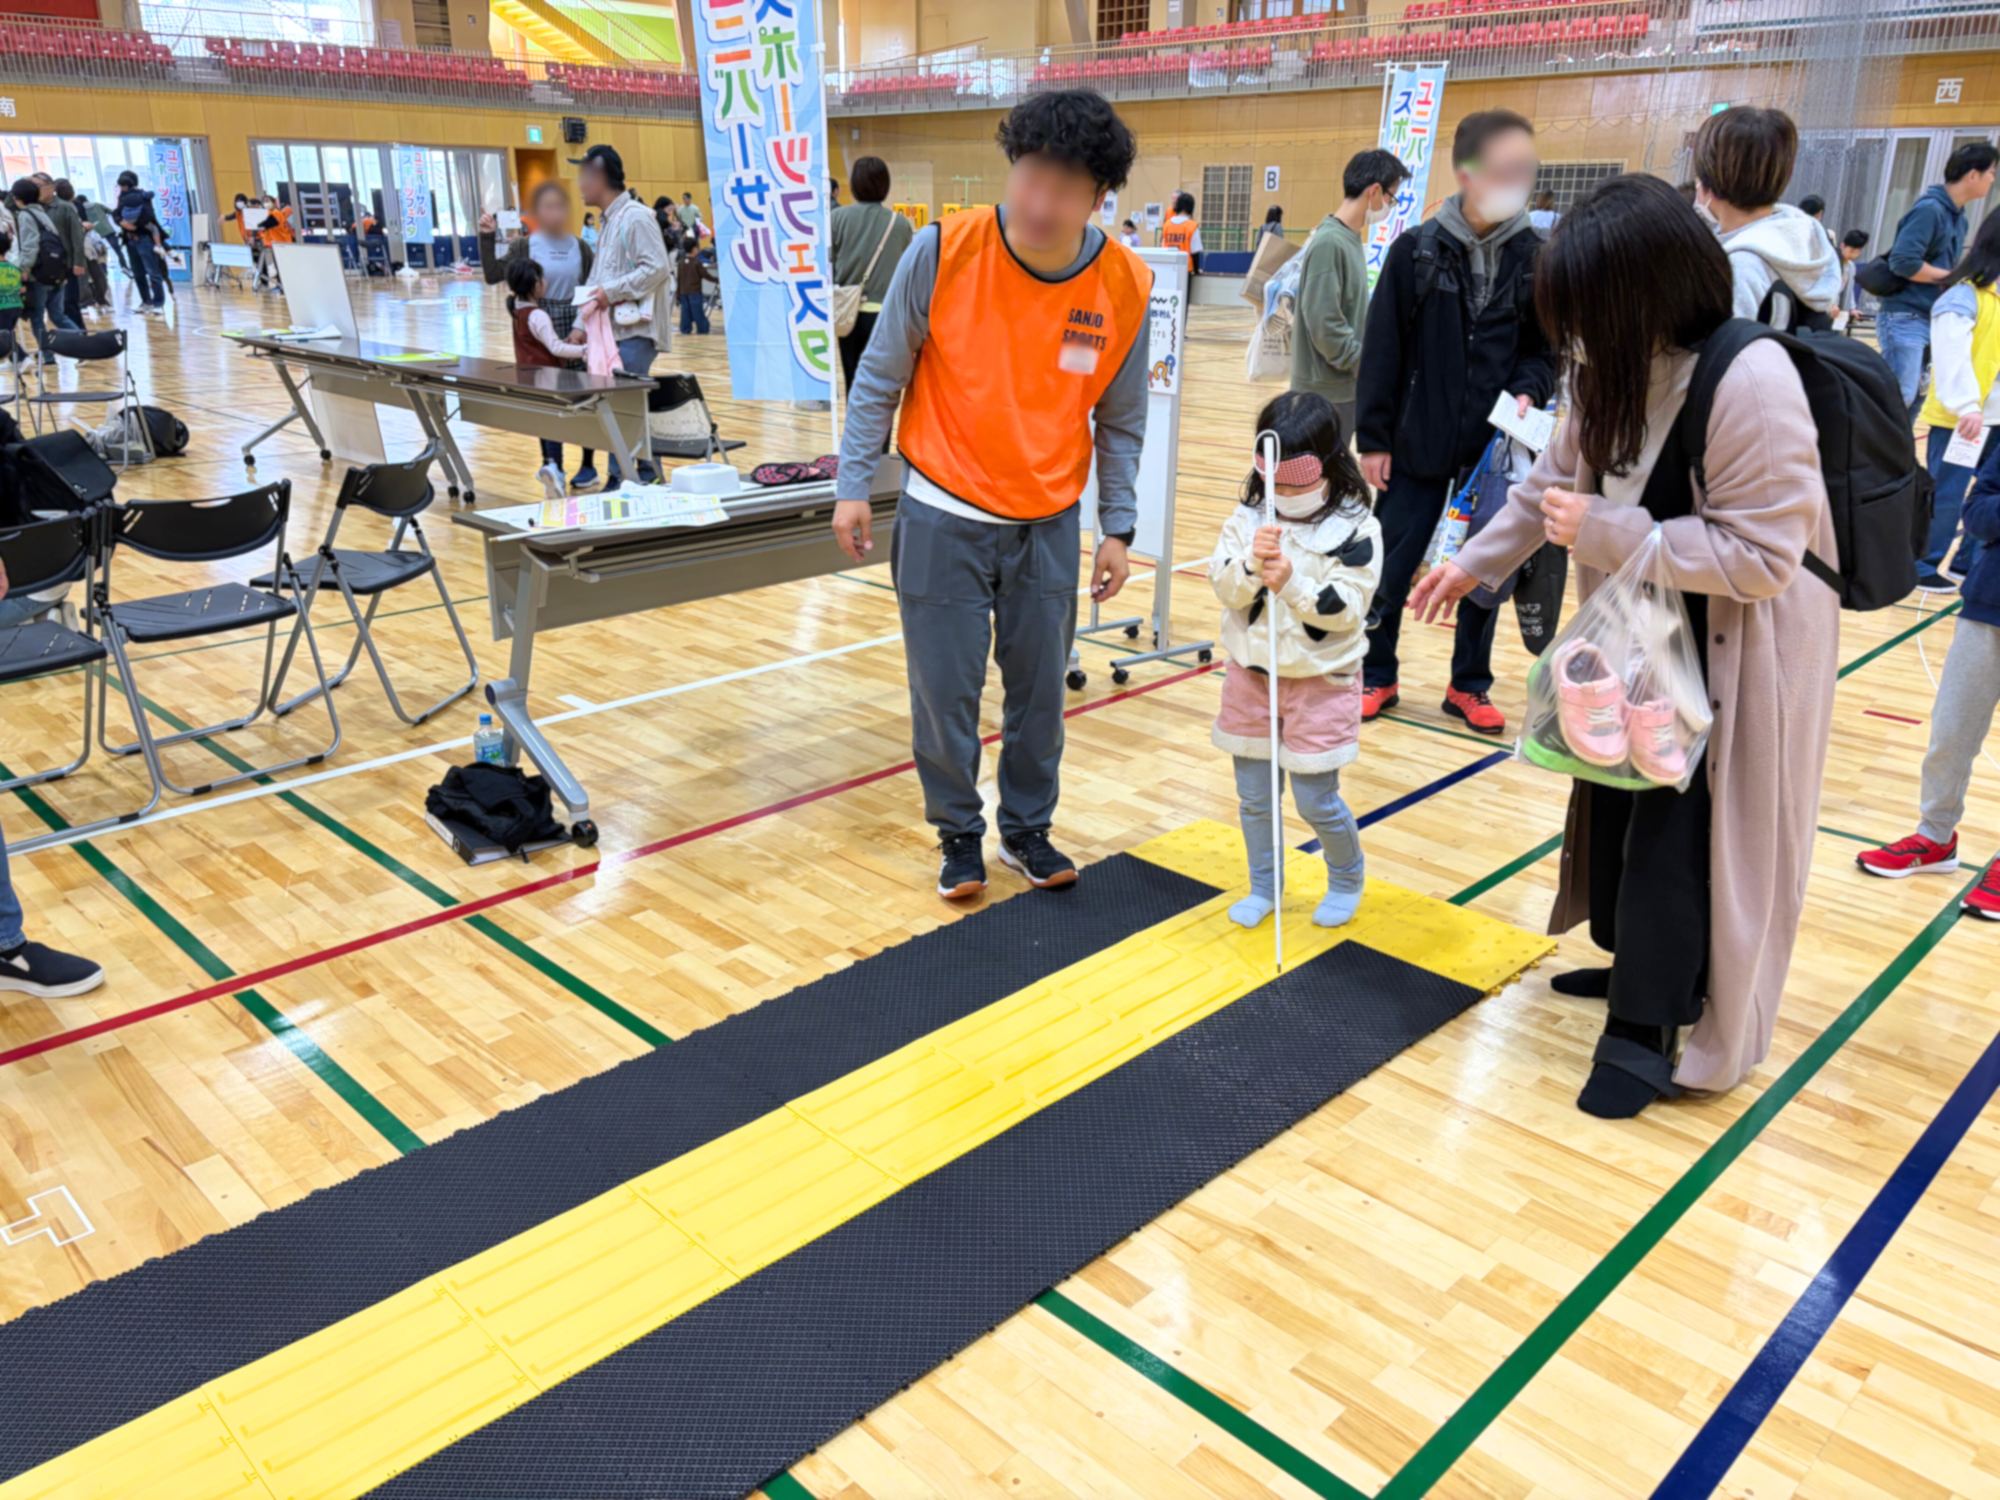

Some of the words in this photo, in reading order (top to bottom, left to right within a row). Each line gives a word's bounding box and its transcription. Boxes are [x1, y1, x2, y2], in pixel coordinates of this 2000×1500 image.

[1934, 78, 1964, 104] 西
[167, 150, 184, 218] ユニバーサル
[414, 152, 427, 216] ユニバーサル
[1267, 171, 1277, 190] B
[403, 155, 417, 237] スポーツフェスタ
[1165, 233, 1186, 244] STAFF
[1068, 308, 1104, 329] SANJO
